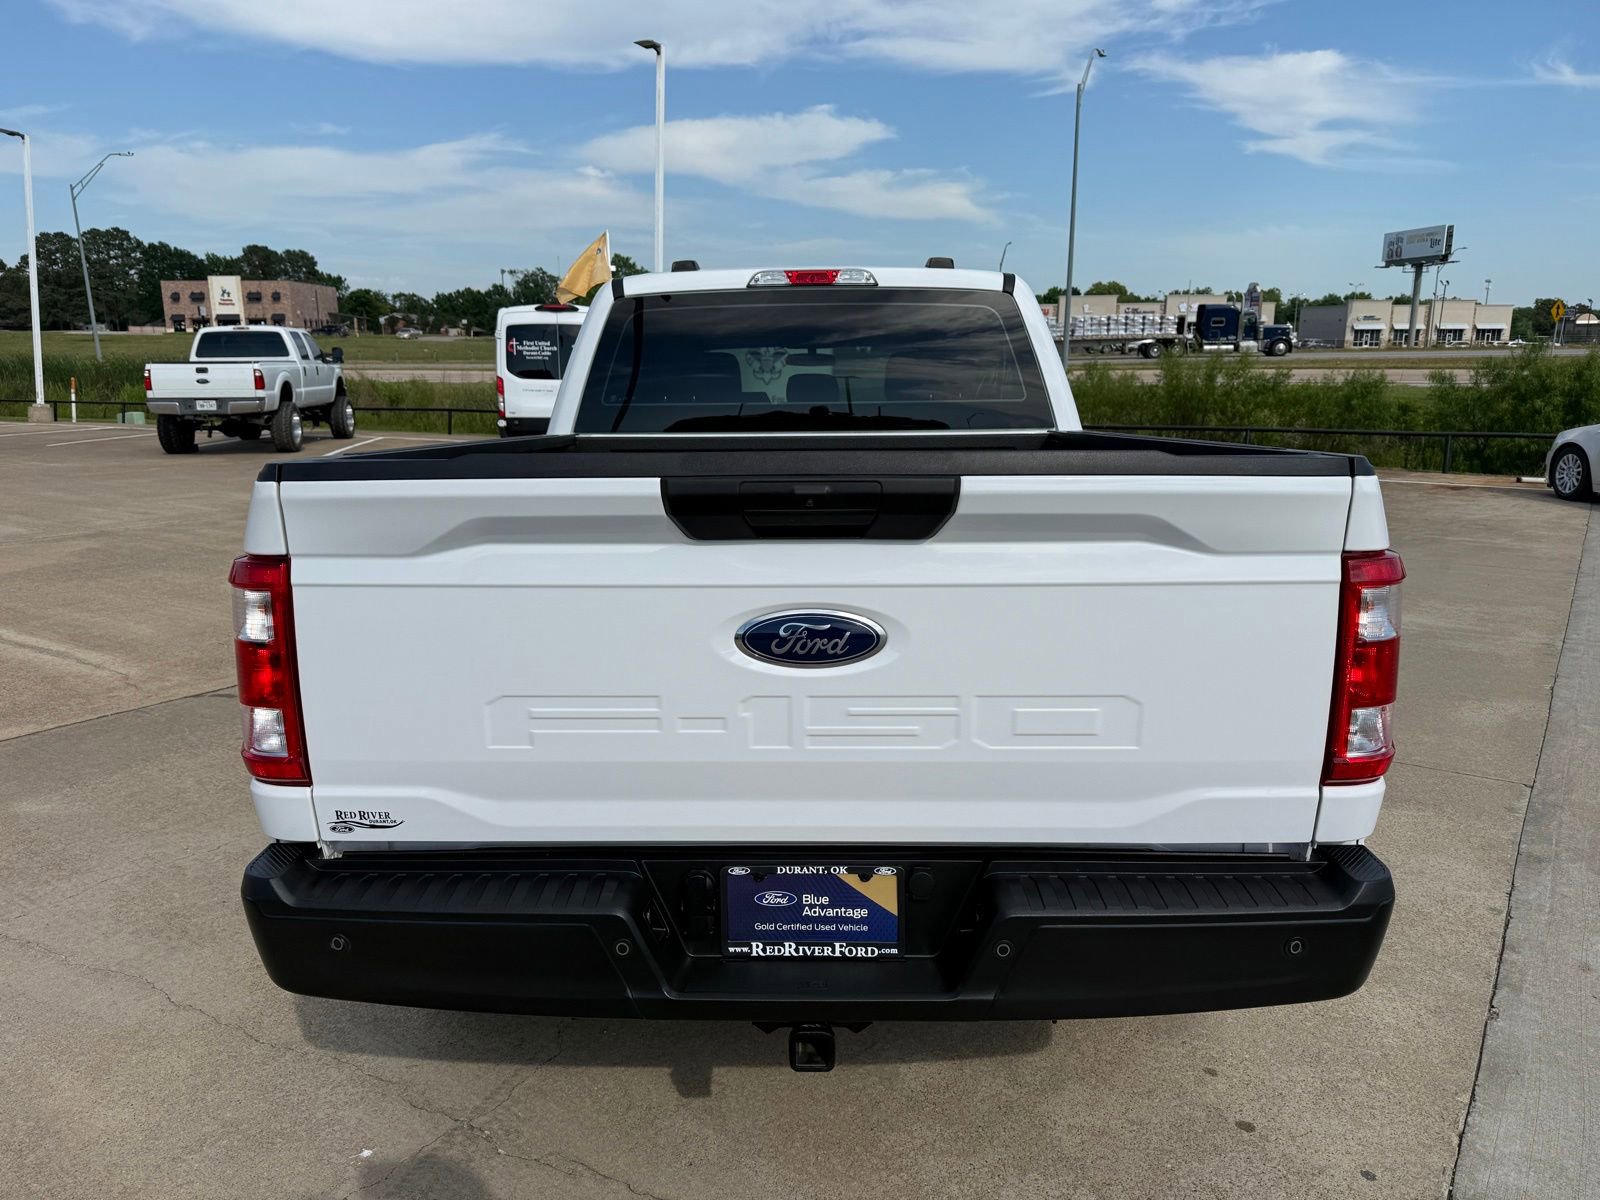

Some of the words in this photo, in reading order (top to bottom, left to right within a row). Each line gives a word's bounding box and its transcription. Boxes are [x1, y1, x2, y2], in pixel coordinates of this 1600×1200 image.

[770, 622, 851, 655] Ford
[484, 695, 1143, 751] F-150
[777, 866, 828, 875] DURANT,
[831, 866, 848, 875] OK
[762, 893, 789, 905] Ford
[802, 894, 829, 905] Blue
[802, 906, 868, 919] Advantage
[754, 922, 775, 931] Gold
[776, 922, 813, 931] Certified
[814, 923, 836, 931] Used
[838, 923, 869, 932] Vehicle
